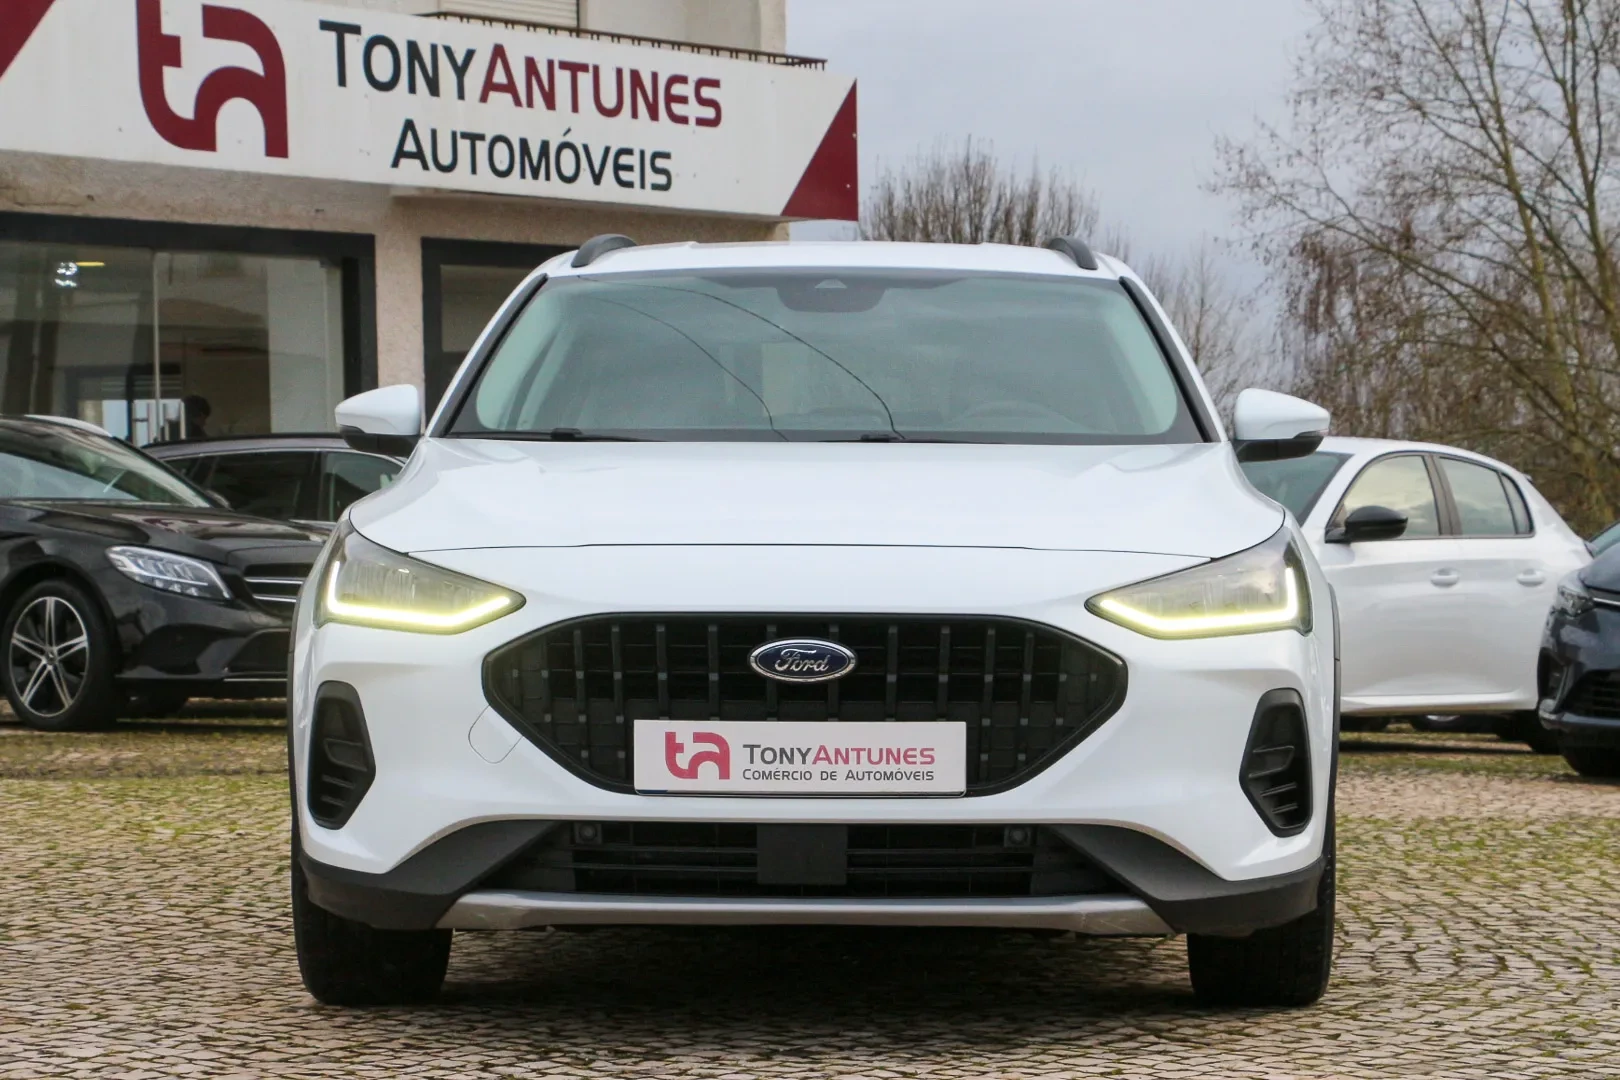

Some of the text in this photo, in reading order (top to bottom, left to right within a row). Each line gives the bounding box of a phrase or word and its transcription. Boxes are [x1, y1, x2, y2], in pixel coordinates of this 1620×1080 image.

[391, 118, 673, 191] AUTOMÓVEIS
[774, 648, 830, 672] Ford
[820, 770, 838, 781] DE
